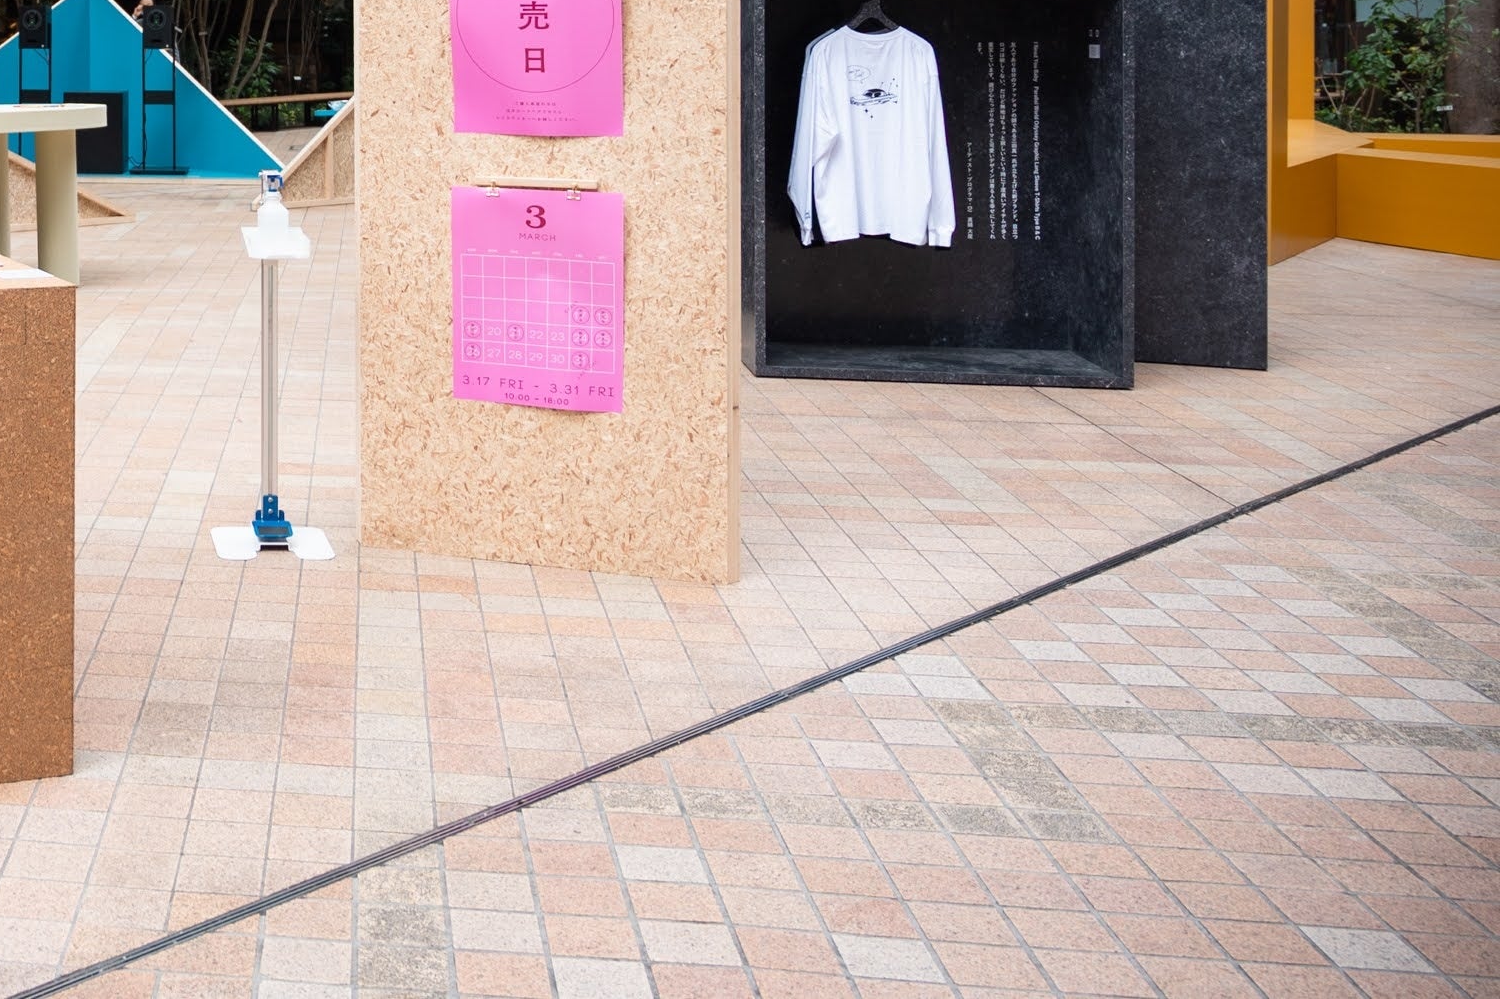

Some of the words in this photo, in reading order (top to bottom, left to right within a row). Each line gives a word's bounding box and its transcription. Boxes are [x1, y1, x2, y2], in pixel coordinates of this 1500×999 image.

[525, 205, 547, 229] 3
[518, 233, 557, 242] MARCH
[487, 326, 502, 336] 20
[529, 330, 544, 340] 22
[550, 331, 565, 341] 23
[487, 347, 501, 357] 27
[508, 350, 523, 360] 28
[529, 351, 543, 362] 29
[550, 353, 565, 364] 30
[462, 374, 490, 386] 3.17
[500, 378, 524, 390] FRI
[549, 383, 579, 395] 3.31
[588, 386, 615, 397] FRI
